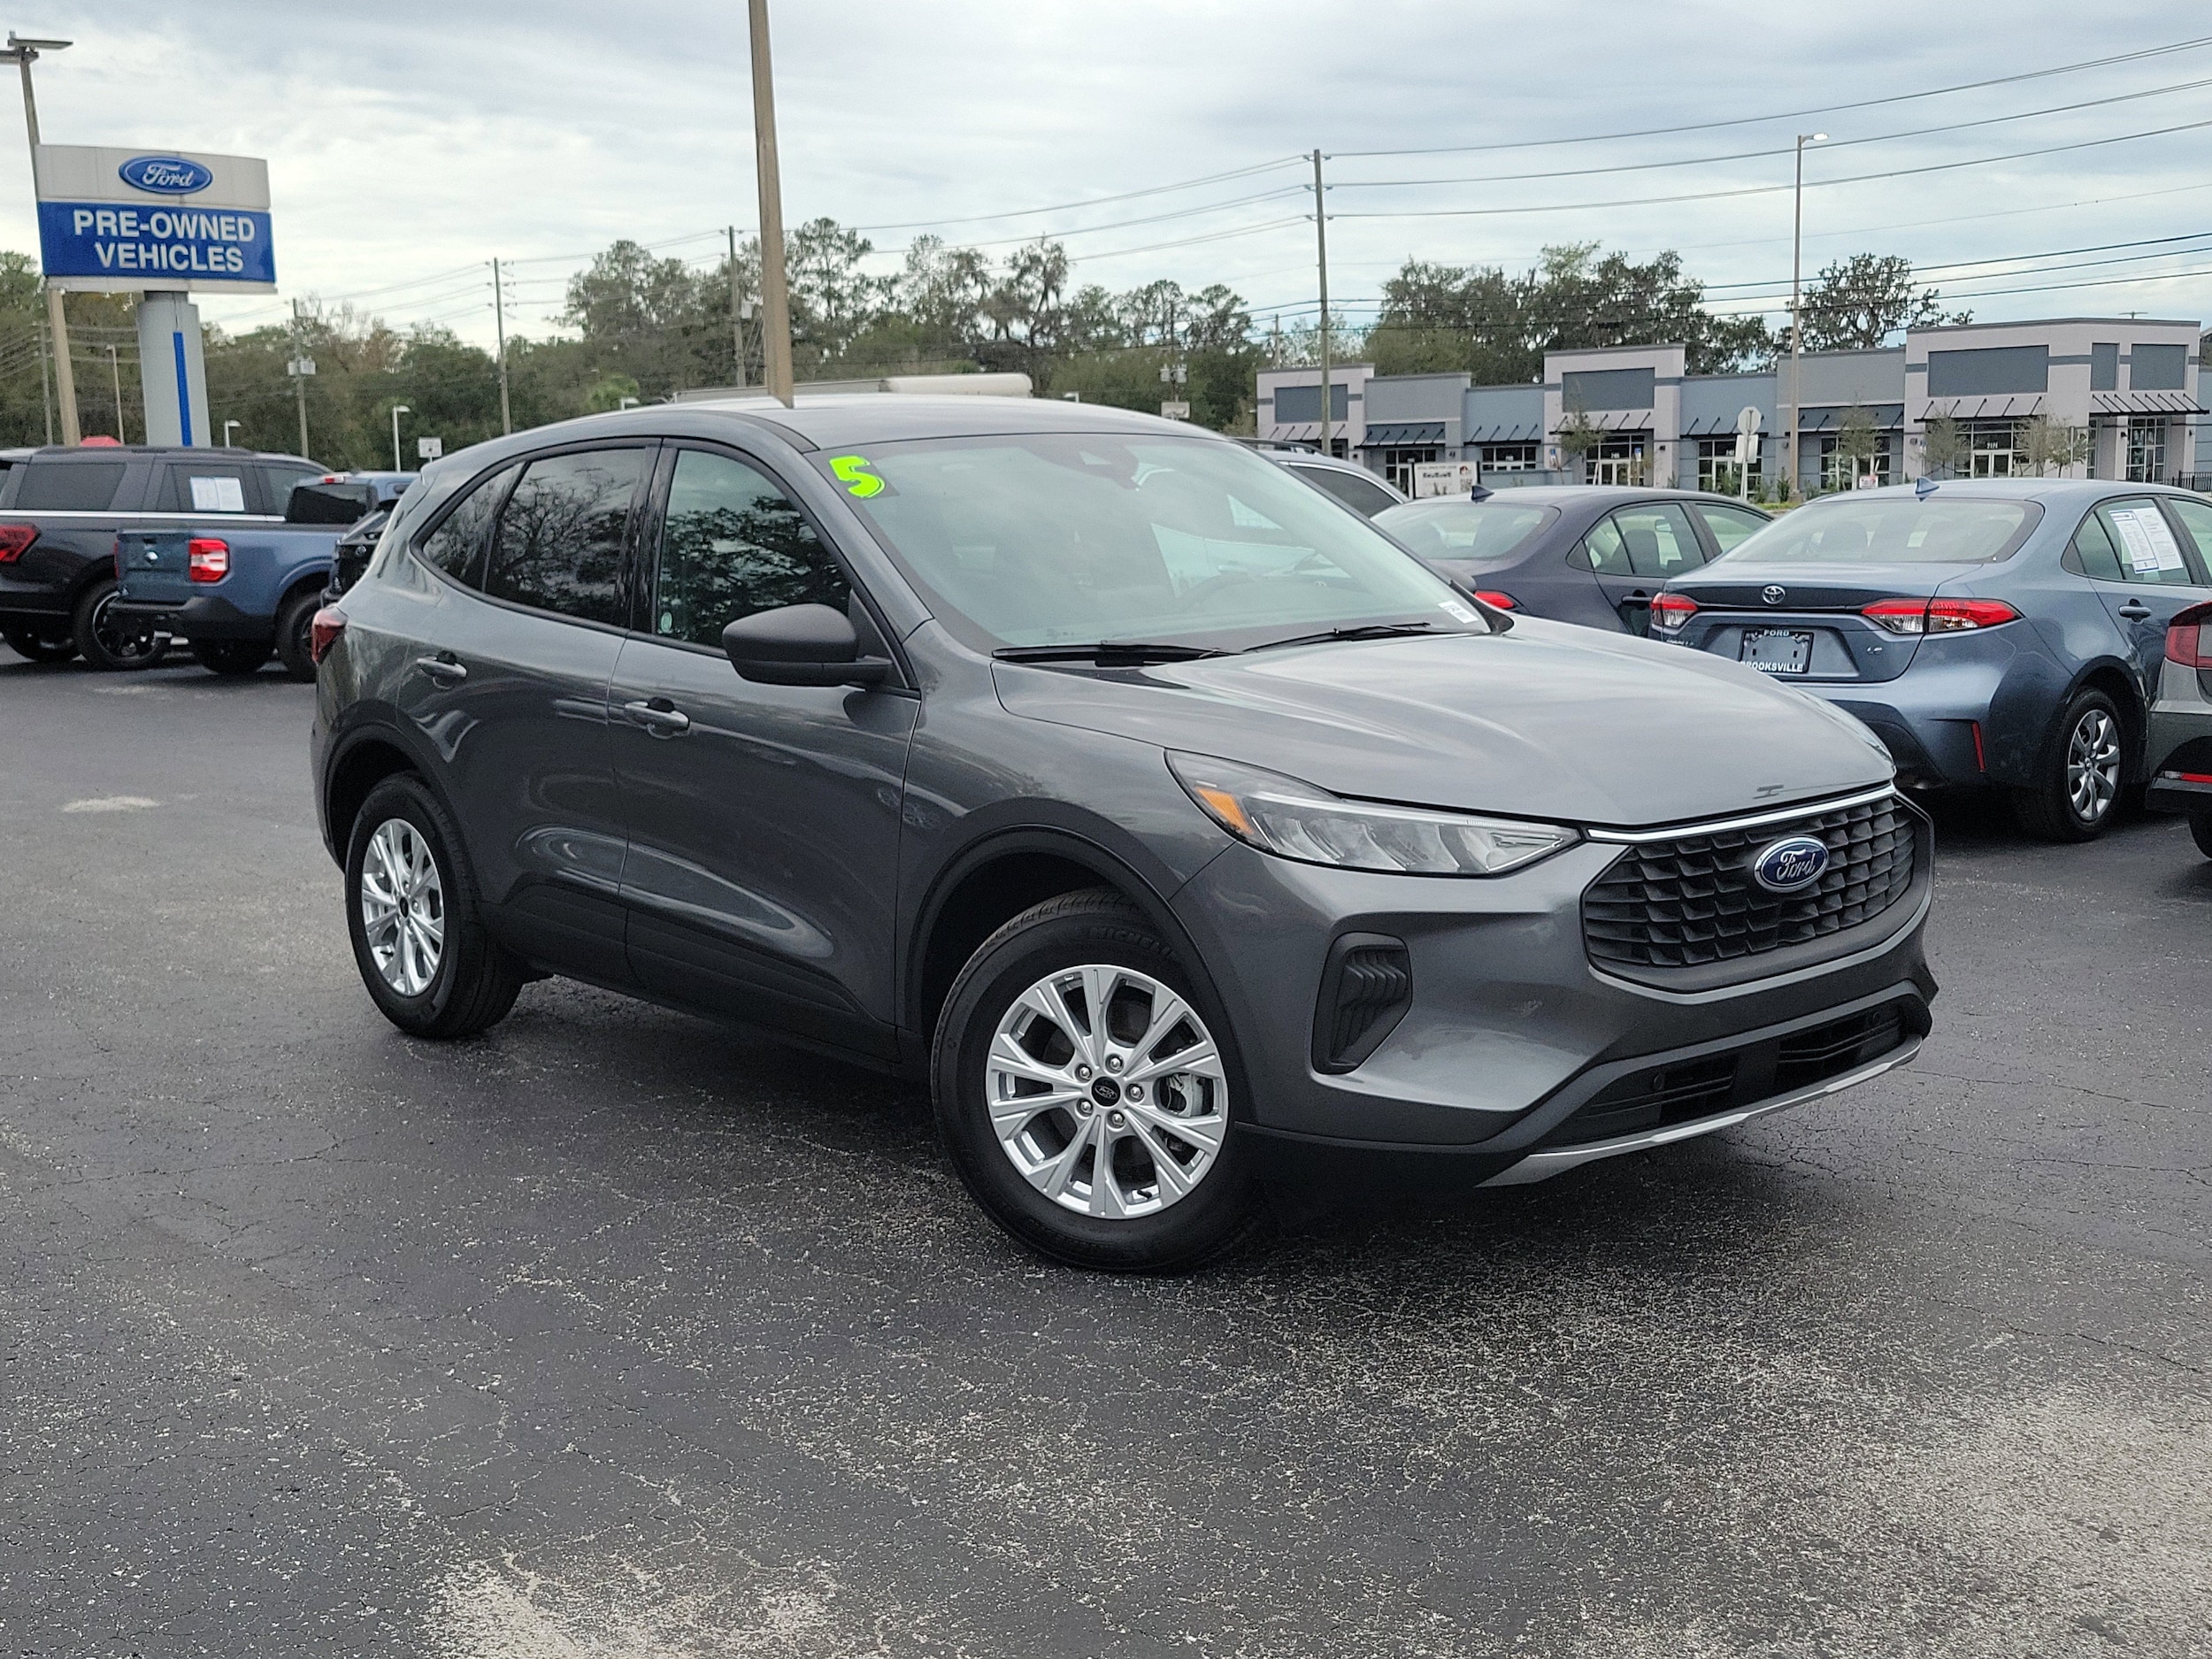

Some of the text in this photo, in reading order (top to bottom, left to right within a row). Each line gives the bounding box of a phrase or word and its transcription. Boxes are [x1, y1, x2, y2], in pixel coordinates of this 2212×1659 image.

[142, 163, 196, 187] Ford
[73, 210, 256, 242] PRE-OWNED
[95, 242, 244, 273] VEHICLES
[828, 455, 886, 498] 5
[1776, 848, 1816, 881] Ford
